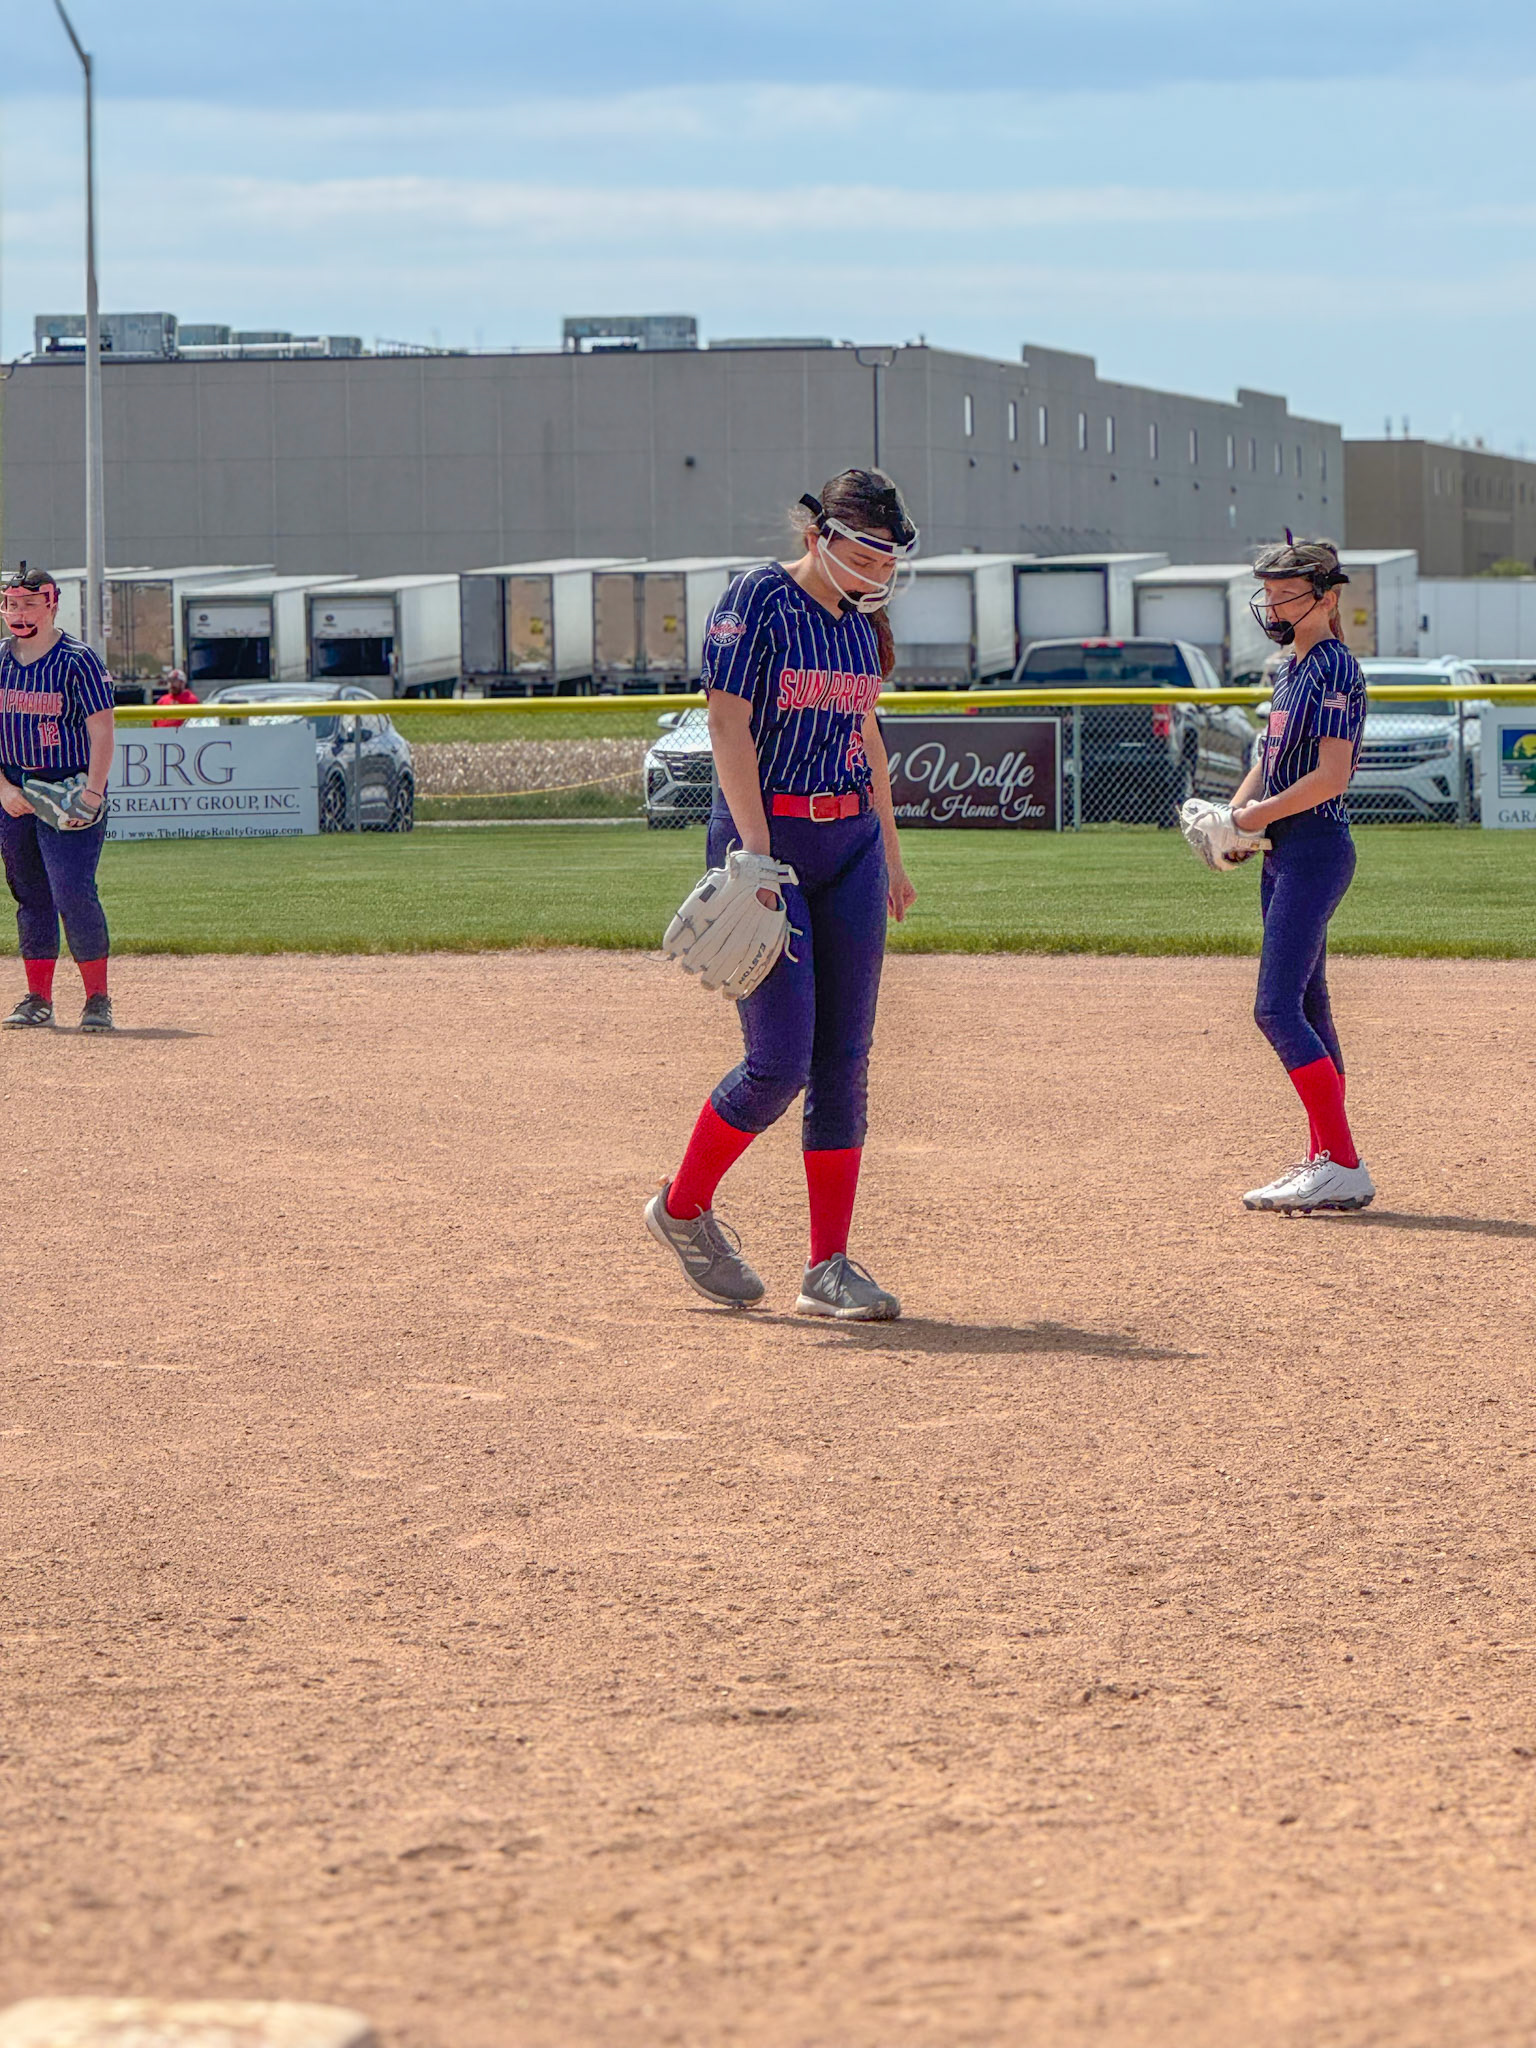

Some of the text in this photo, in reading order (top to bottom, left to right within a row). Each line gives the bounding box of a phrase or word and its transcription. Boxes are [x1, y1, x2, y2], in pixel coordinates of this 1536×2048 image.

[777, 668, 828, 711] SUN
[38, 722, 60, 747] 12
[116, 741, 236, 788] BRG
[904, 742, 1035, 805] Wolfe
[126, 796, 192, 812] REALTY
[197, 795, 260, 811] GROUP,
[264, 793, 300, 809] INC.
[930, 794, 999, 822] Home
[1001, 793, 1045, 822] Inc
[738, 942, 766, 985] EASTON
